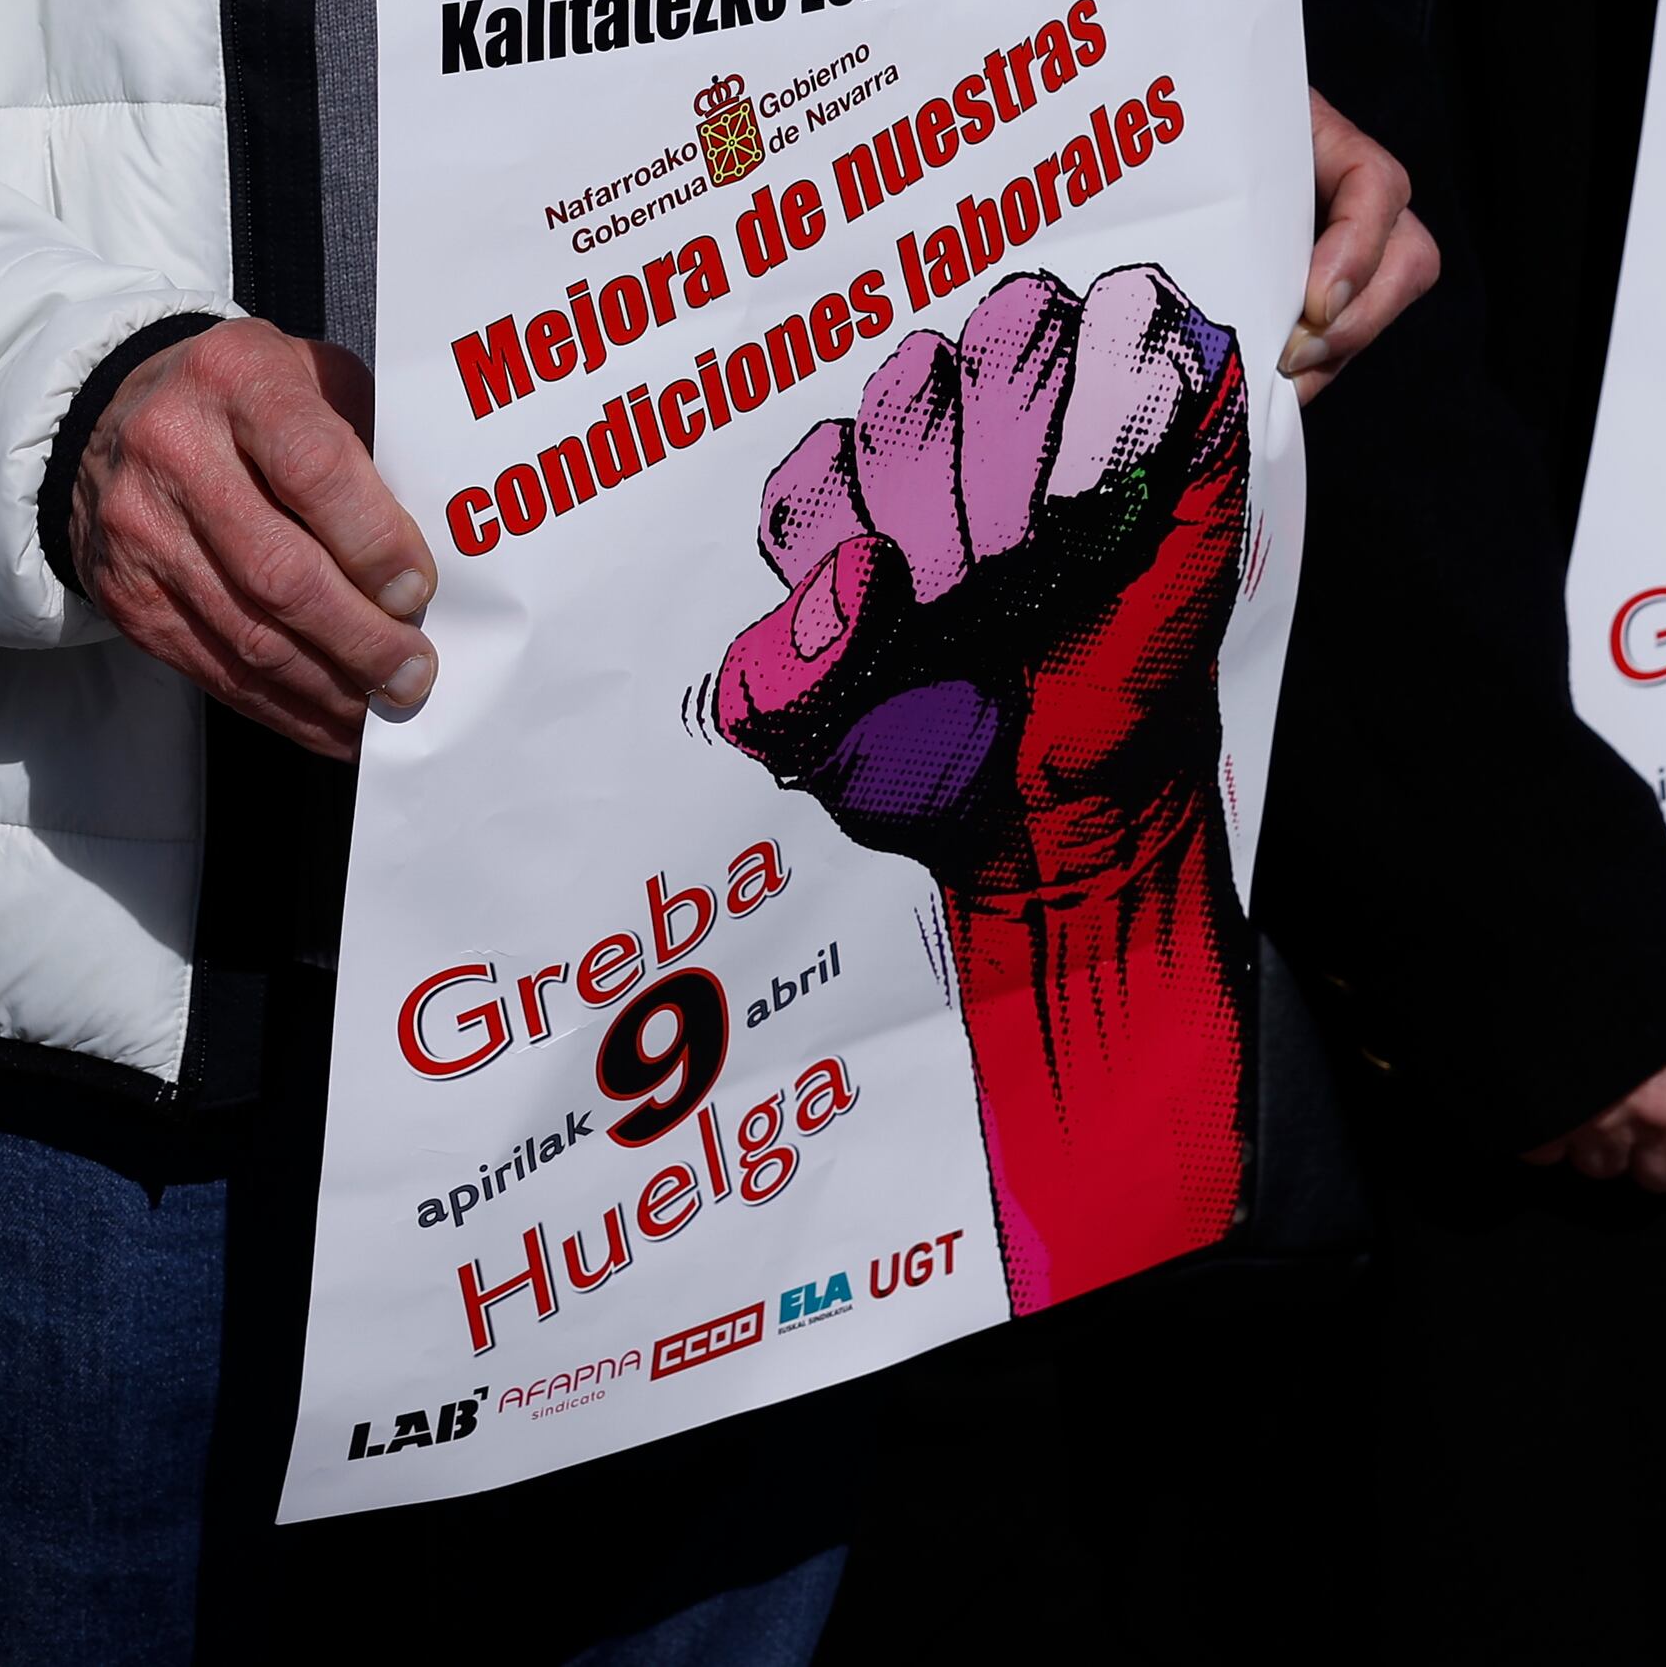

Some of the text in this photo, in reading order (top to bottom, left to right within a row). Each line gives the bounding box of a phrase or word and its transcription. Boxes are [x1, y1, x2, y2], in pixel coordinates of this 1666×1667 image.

[759, 42, 872, 120] Gobierno
[767, 61, 900, 156] de Navarra
[544, 137, 699, 230] Nafarroako
[571, 175, 710, 254] Gobernua
[445, 75, 1186, 558] condiciones laborales
[450, 235, 729, 421] Mejora
[737, 175, 827, 280] de
[395, 838, 792, 1078] Greba
[417, 941, 841, 1227] apirilak 9 abril
[456, 1055, 860, 1356] Huelga
[779, 1271, 853, 1324] ELA
[869, 1229, 964, 1301] UGT
[660, 1311, 757, 1370] CCOO
[499, 1349, 642, 1417] AFAPNA
[531, 1387, 606, 1421] sindicato
[347, 1385, 490, 1461] LAB
